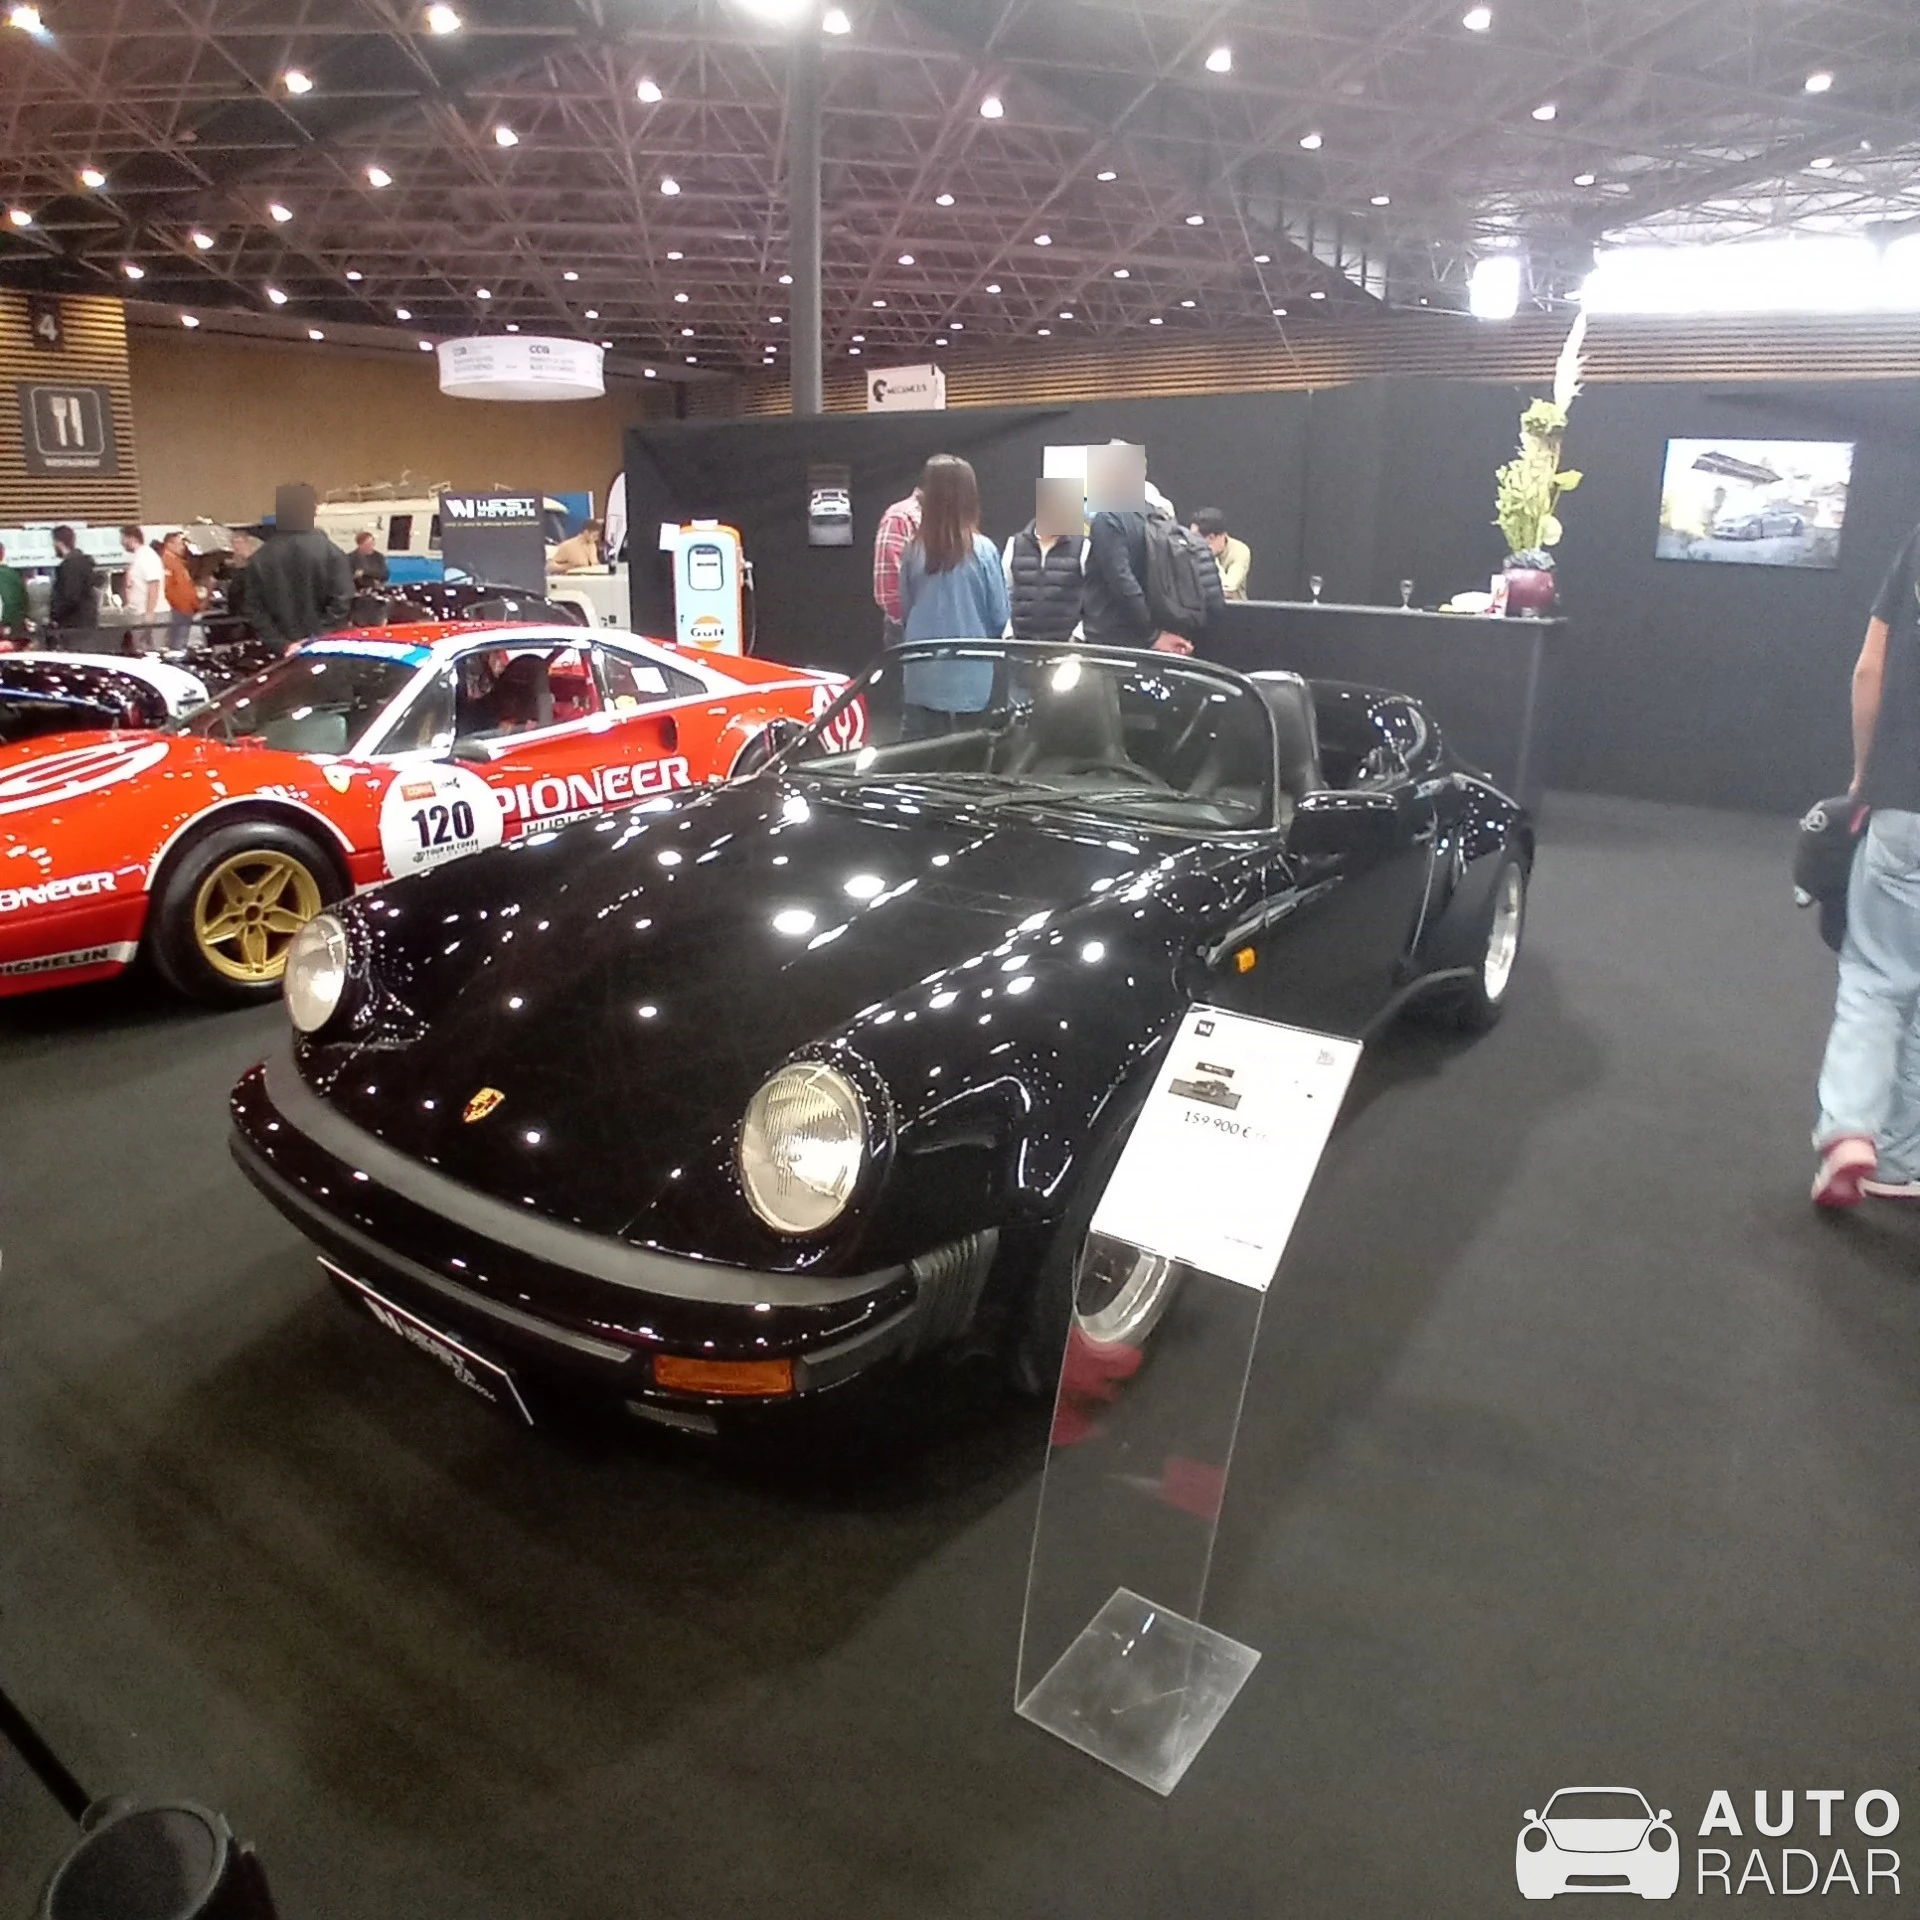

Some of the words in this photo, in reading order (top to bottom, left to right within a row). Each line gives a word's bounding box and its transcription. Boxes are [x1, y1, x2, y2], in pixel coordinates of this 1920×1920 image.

[38, 313, 58, 341] 4
[477, 499, 535, 511] WEST
[691, 626, 724, 637] Gulf
[494, 756, 692, 818] PIONEER
[411, 800, 474, 848] 120
[527, 811, 599, 835] HUBO
[0, 948, 109, 975] ICHELIN
[1184, 1111, 1210, 1124] 159
[1213, 1118, 1240, 1134] 900
